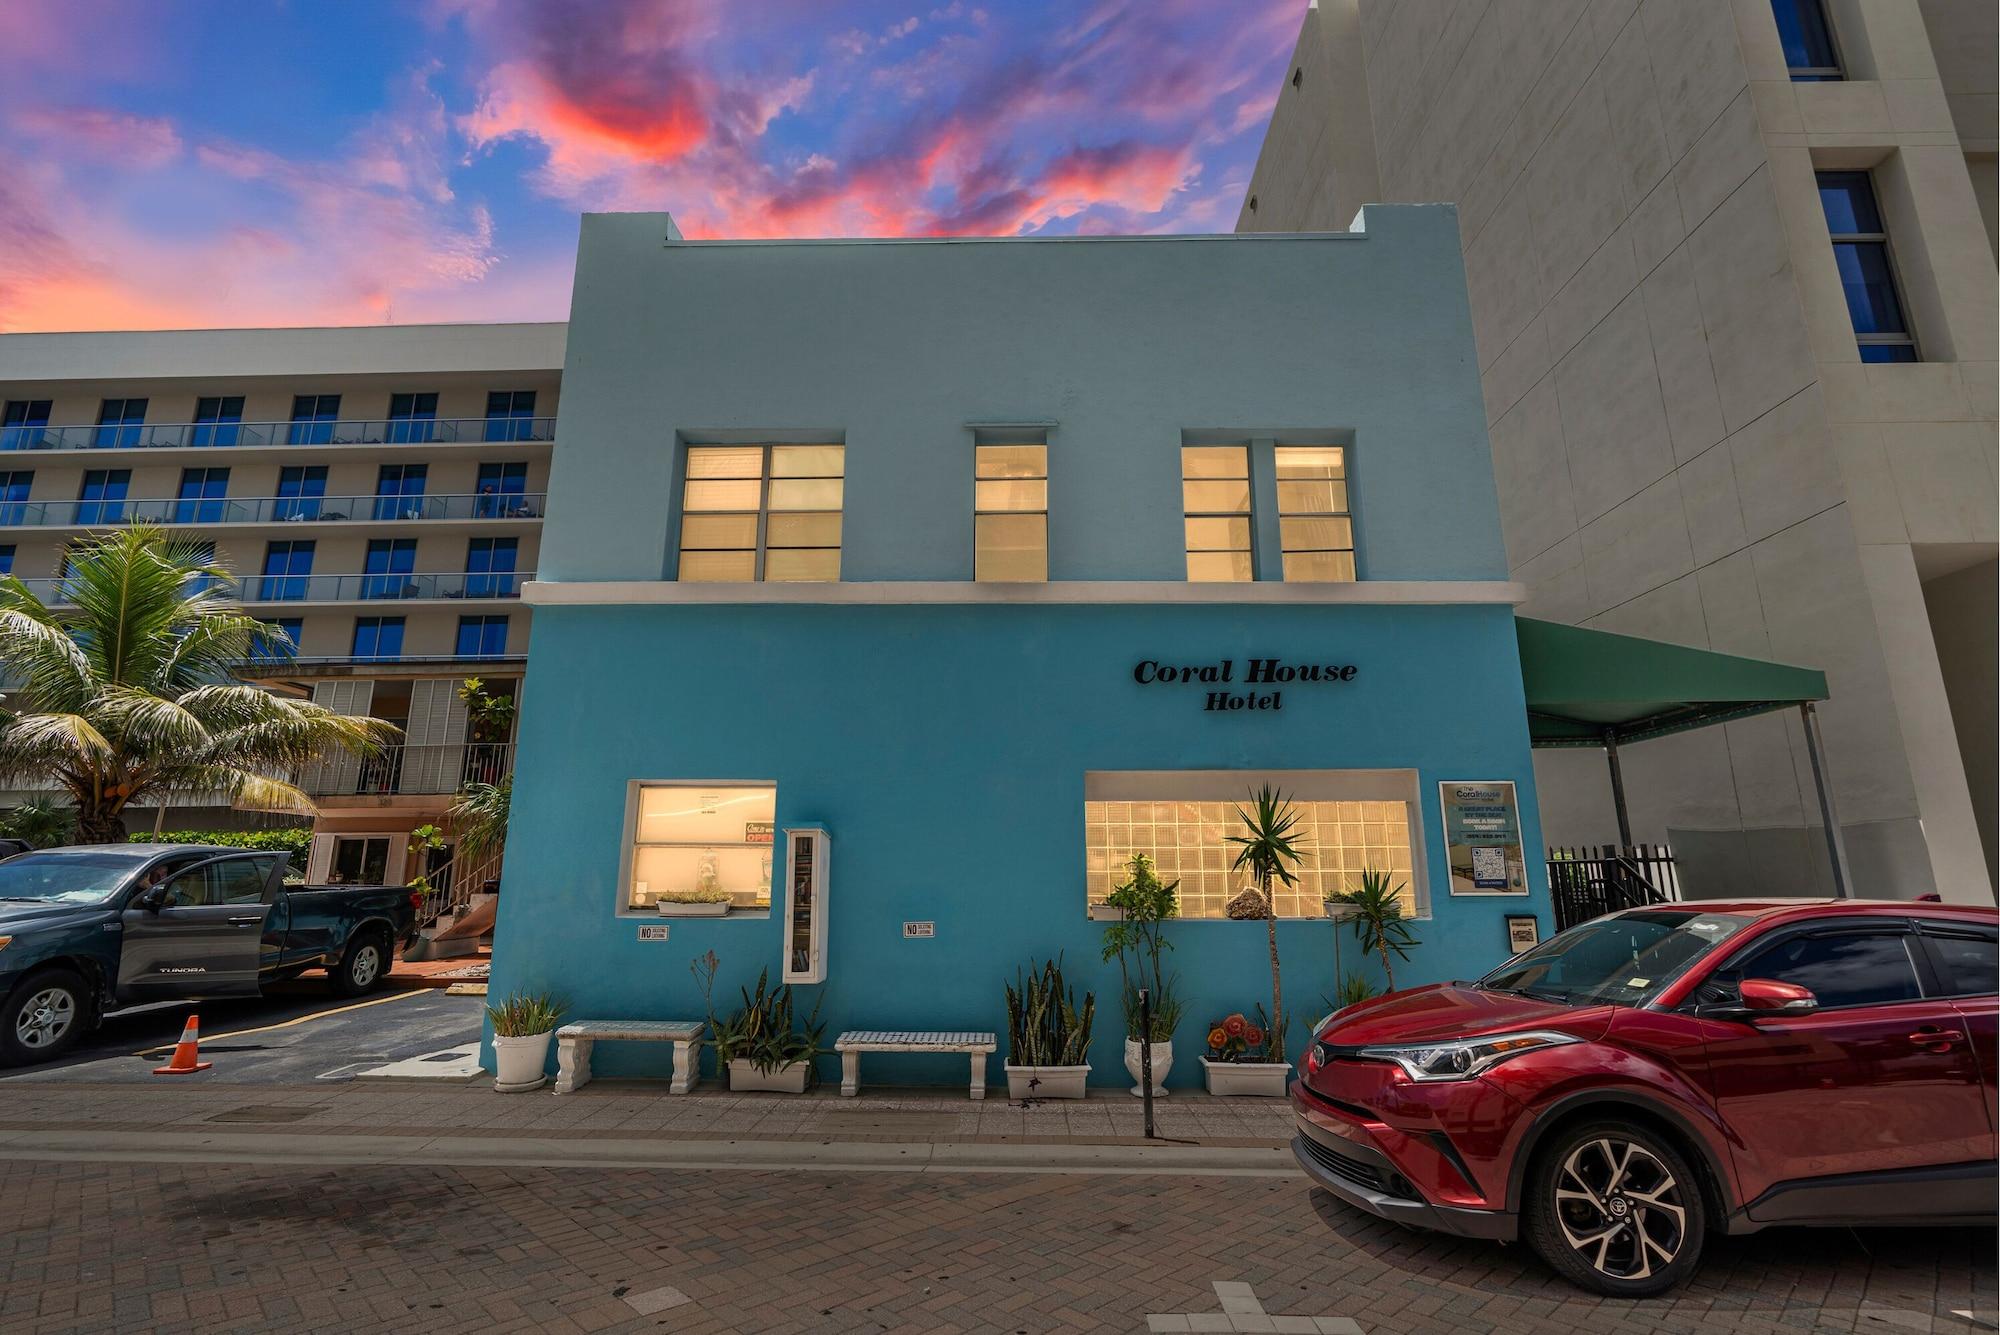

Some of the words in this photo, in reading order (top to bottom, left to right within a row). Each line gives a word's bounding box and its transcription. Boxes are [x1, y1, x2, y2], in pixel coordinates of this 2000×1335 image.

[1134, 660, 1233, 684] Coral
[1244, 659, 1358, 683] House
[1203, 692, 1283, 711] Hotel
[641, 928, 651, 938] NO
[907, 925, 917, 934] NO
